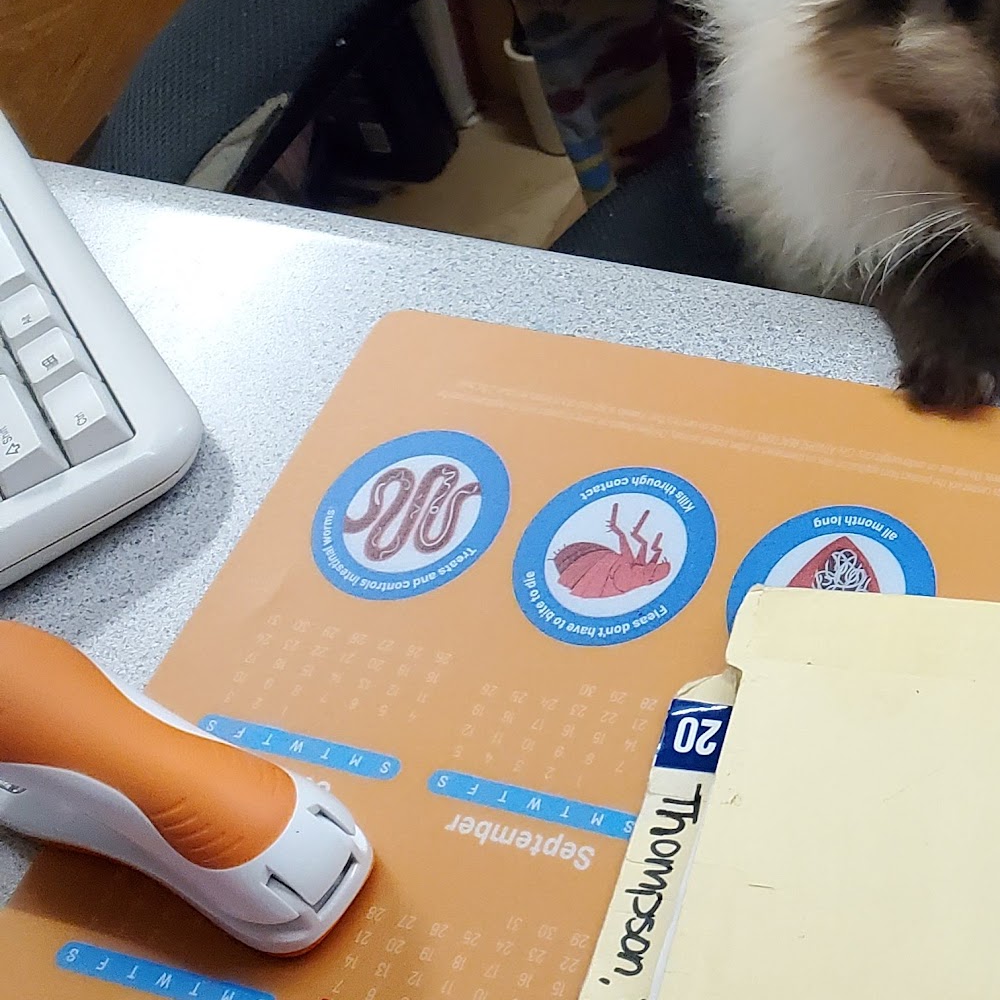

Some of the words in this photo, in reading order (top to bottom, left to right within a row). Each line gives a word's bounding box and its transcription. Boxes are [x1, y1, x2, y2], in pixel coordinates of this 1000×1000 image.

[579, 477, 629, 501] contact
[632, 475, 675, 497] through
[674, 491, 695, 513] Kills
[813, 516, 842, 529] long
[844, 516, 883, 532] month
[321, 508, 334, 552] worms
[881, 527, 898, 541] all
[322, 546, 359, 587] intestinal
[438, 546, 478, 577] Treats
[359, 577, 411, 593] controls
[412, 570, 437, 589] and
[522, 570, 538, 590] die
[528, 588, 541, 603] to
[534, 599, 555, 624] bite
[632, 604, 668, 628] Fleas
[551, 615, 567, 630] to
[566, 622, 597, 638] have
[597, 622, 630, 638] don't
[481, 683, 498, 697] 26
[580, 685, 596, 697] 30
[512, 691, 528, 704] 25
[541, 698, 558, 710] 24
[610, 691, 628, 704] 29
[640, 698, 658, 710] 28
[472, 704, 484, 716] 19
[570, 704, 587, 717] 23
[501, 711, 514, 724] 18
[600, 711, 618, 724] 22
[206, 720, 217, 732] S
[462, 724, 474, 737] 12
[531, 719, 544, 731] 17
[561, 724, 575, 738] 16
[632, 719, 648, 731] 21
[233, 728, 246, 738] F
[262, 734, 272, 745] T
[491, 732, 503, 745] 11
[593, 732, 605, 744] 15
[673, 717, 722, 756] 20
[289, 740, 303, 753] W
[454, 745, 463, 757] 5
[521, 738, 535, 752] 10
[554, 746, 564, 757] 9
[625, 739, 637, 751] 14
[320, 748, 330, 759] T
[349, 754, 362, 766] M
[584, 753, 595, 765] 8
[380, 761, 392, 774] S
[513, 759, 524, 771] 3
[615, 761, 624, 773] 7
[545, 766, 555, 780] 2
[438, 776, 448, 787] S
[467, 784, 479, 795] F
[497, 791, 507, 803] T
[527, 798, 541, 810] W
[560, 806, 569, 818] T
[591, 813, 604, 826] M
[624, 821, 634, 834] S
[444, 814, 596, 871] September
[599, 783, 702, 985] Thompson,
[366, 906, 385, 921] 28
[397, 915, 417, 929] 27
[506, 916, 523, 931] 31
[430, 923, 449, 937] 26
[538, 925, 557, 940] 30
[355, 930, 372, 945] 21
[464, 931, 481, 946] 25
[570, 935, 589, 948] 29
[386, 938, 405, 953] 20
[497, 940, 514, 955] 24
[66, 948, 79, 962] S
[419, 947, 433, 961] 19
[528, 948, 546, 963] 23
[96, 958, 109, 970] F
[345, 954, 358, 969] 14
[452, 955, 466, 970] 18
[560, 957, 580, 972] 22
[127, 966, 138, 979] T
[375, 962, 391, 978] 13
[484, 965, 500, 978] 17
[155, 973, 171, 988] W
[407, 971, 422, 986] 12
[518, 973, 533, 988] 16
[188, 982, 200, 996] T
[332, 980, 343, 993] 7
[441, 981, 453, 995] 11
[551, 981, 565, 996] 15
[221, 990, 235, 1000] M
[473, 988, 488, 1000] 10
